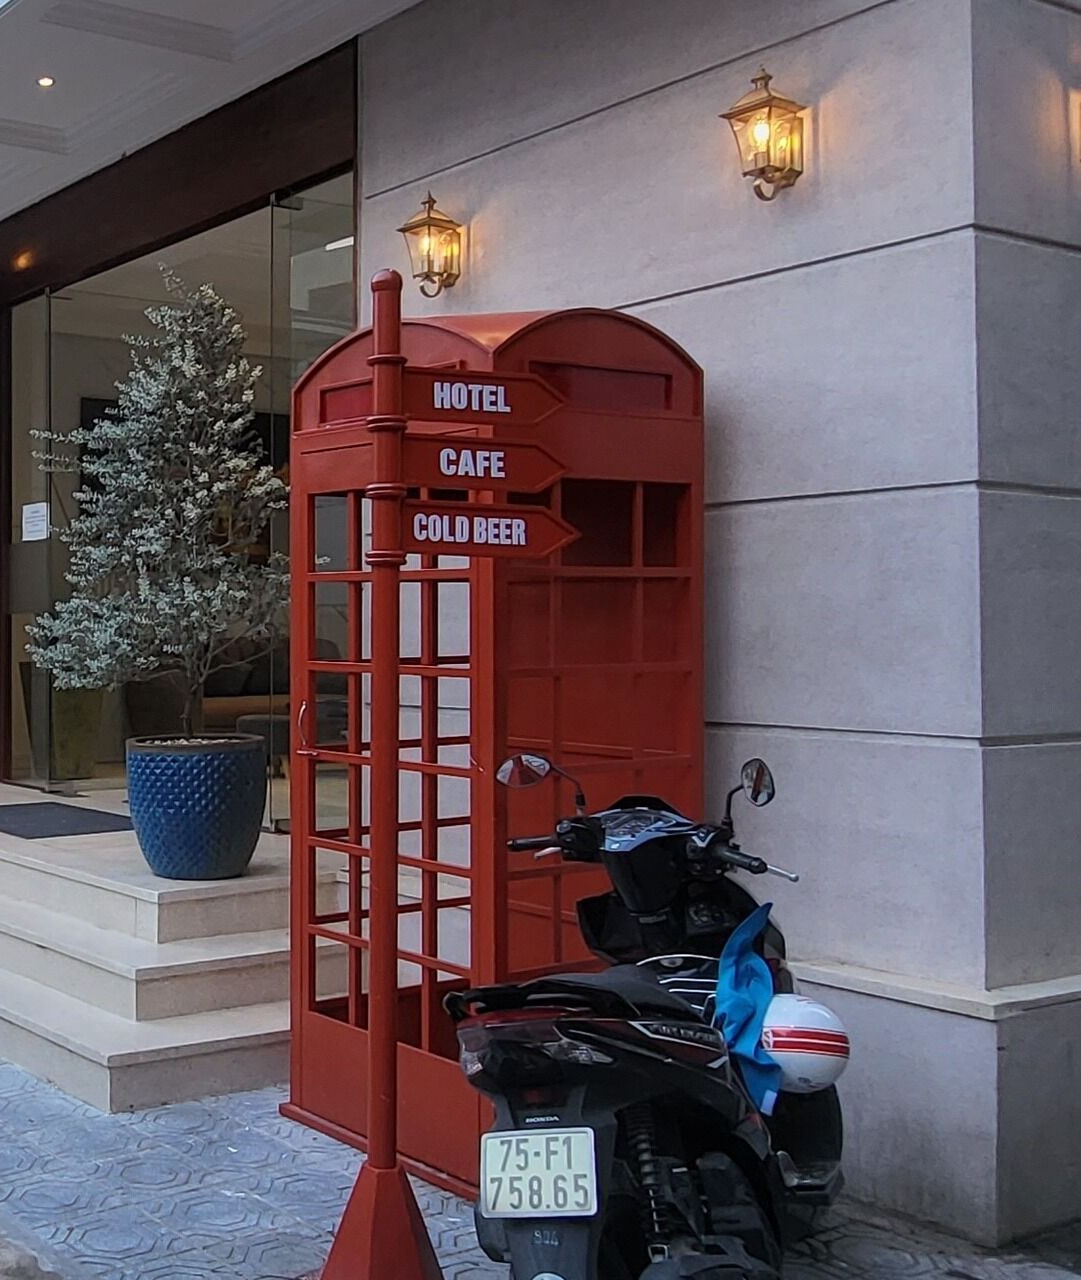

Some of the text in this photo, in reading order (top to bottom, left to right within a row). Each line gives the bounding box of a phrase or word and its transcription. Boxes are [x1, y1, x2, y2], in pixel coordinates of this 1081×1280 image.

[433, 381, 511, 413] HOTEL
[439, 448, 506, 478] CAFE
[413, 513, 527, 545] COLD BEER
[525, 1115, 560, 1123] HONDA
[499, 1136, 573, 1172] 75-F1
[490, 1173, 589, 1211] 758.65
